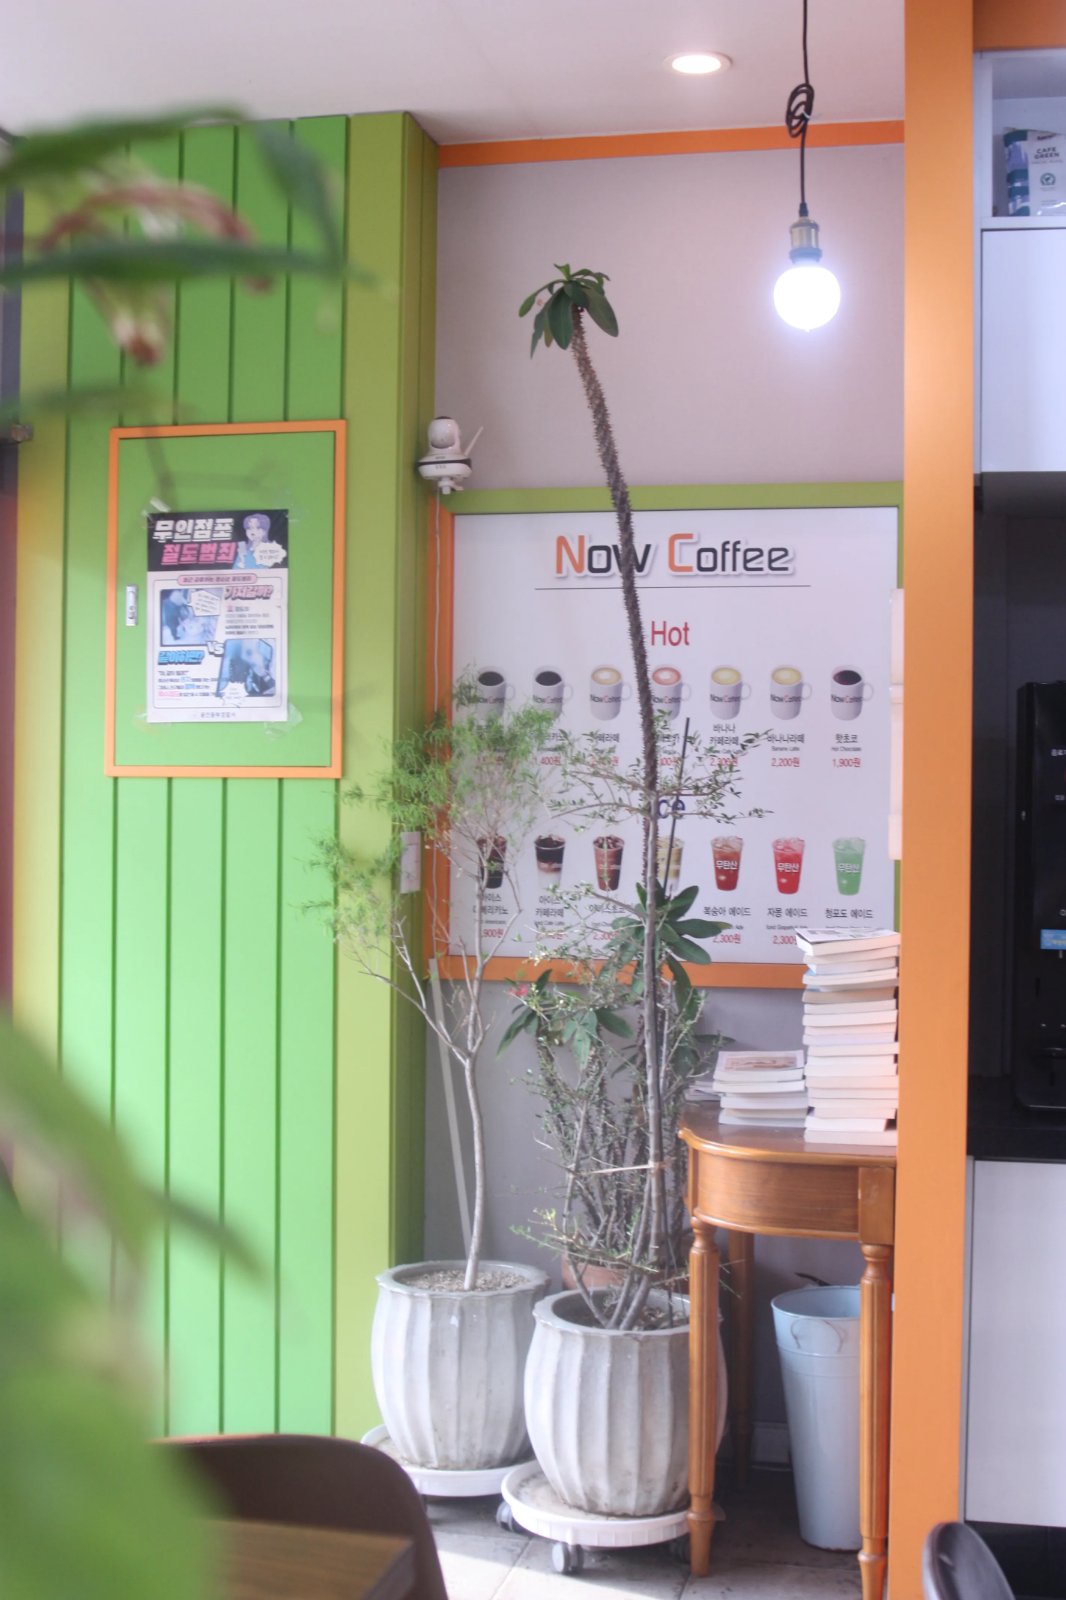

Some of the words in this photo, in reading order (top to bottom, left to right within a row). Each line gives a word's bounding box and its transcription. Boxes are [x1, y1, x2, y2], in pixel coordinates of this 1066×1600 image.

[152, 518, 234, 543] 무인점포
[161, 542, 237, 565] 절도범죄
[556, 535, 652, 574] Now
[668, 533, 789, 573] Coffee
[651, 621, 690, 646] Hot
[712, 724, 736, 733] 바나나
[658, 800, 686, 819] ce
[716, 860, 738, 870] 무탄산
[777, 862, 800, 872] 무탄산
[704, 906, 727, 917] 복숭아
[729, 906, 752, 917] 에이드
[767, 907, 782, 918] 자몽
[785, 907, 808, 918] 에이드
[825, 908, 848, 919] 청포도
[850, 908, 874, 919] 에이드
[772, 935, 797, 945] 2,300
